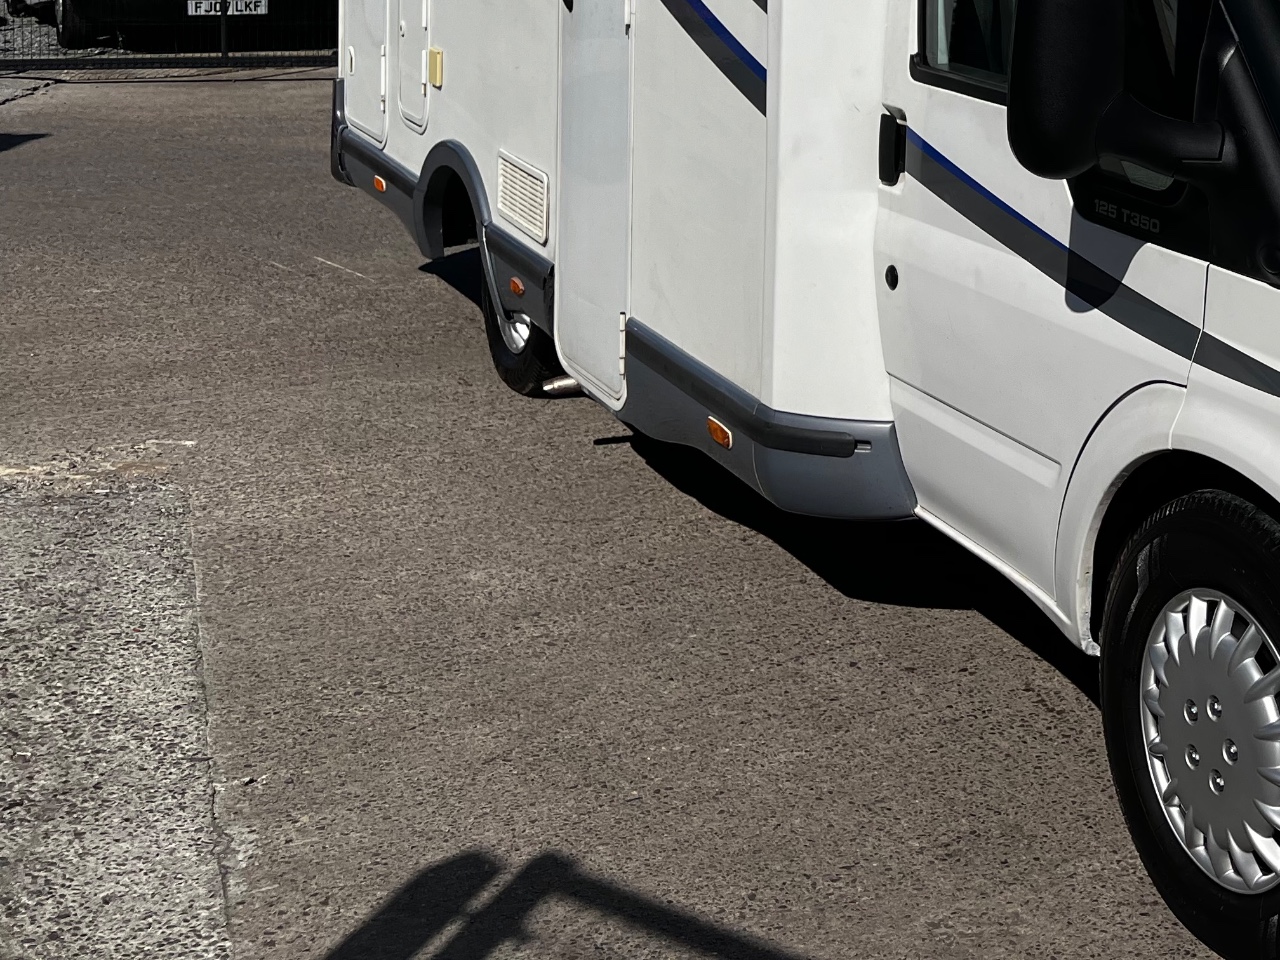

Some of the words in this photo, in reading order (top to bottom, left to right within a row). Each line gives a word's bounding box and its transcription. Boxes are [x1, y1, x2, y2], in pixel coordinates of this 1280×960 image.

[235, 0, 262, 13] LKF
[1094, 199, 1118, 219] 125
[1121, 208, 1160, 233] T350
